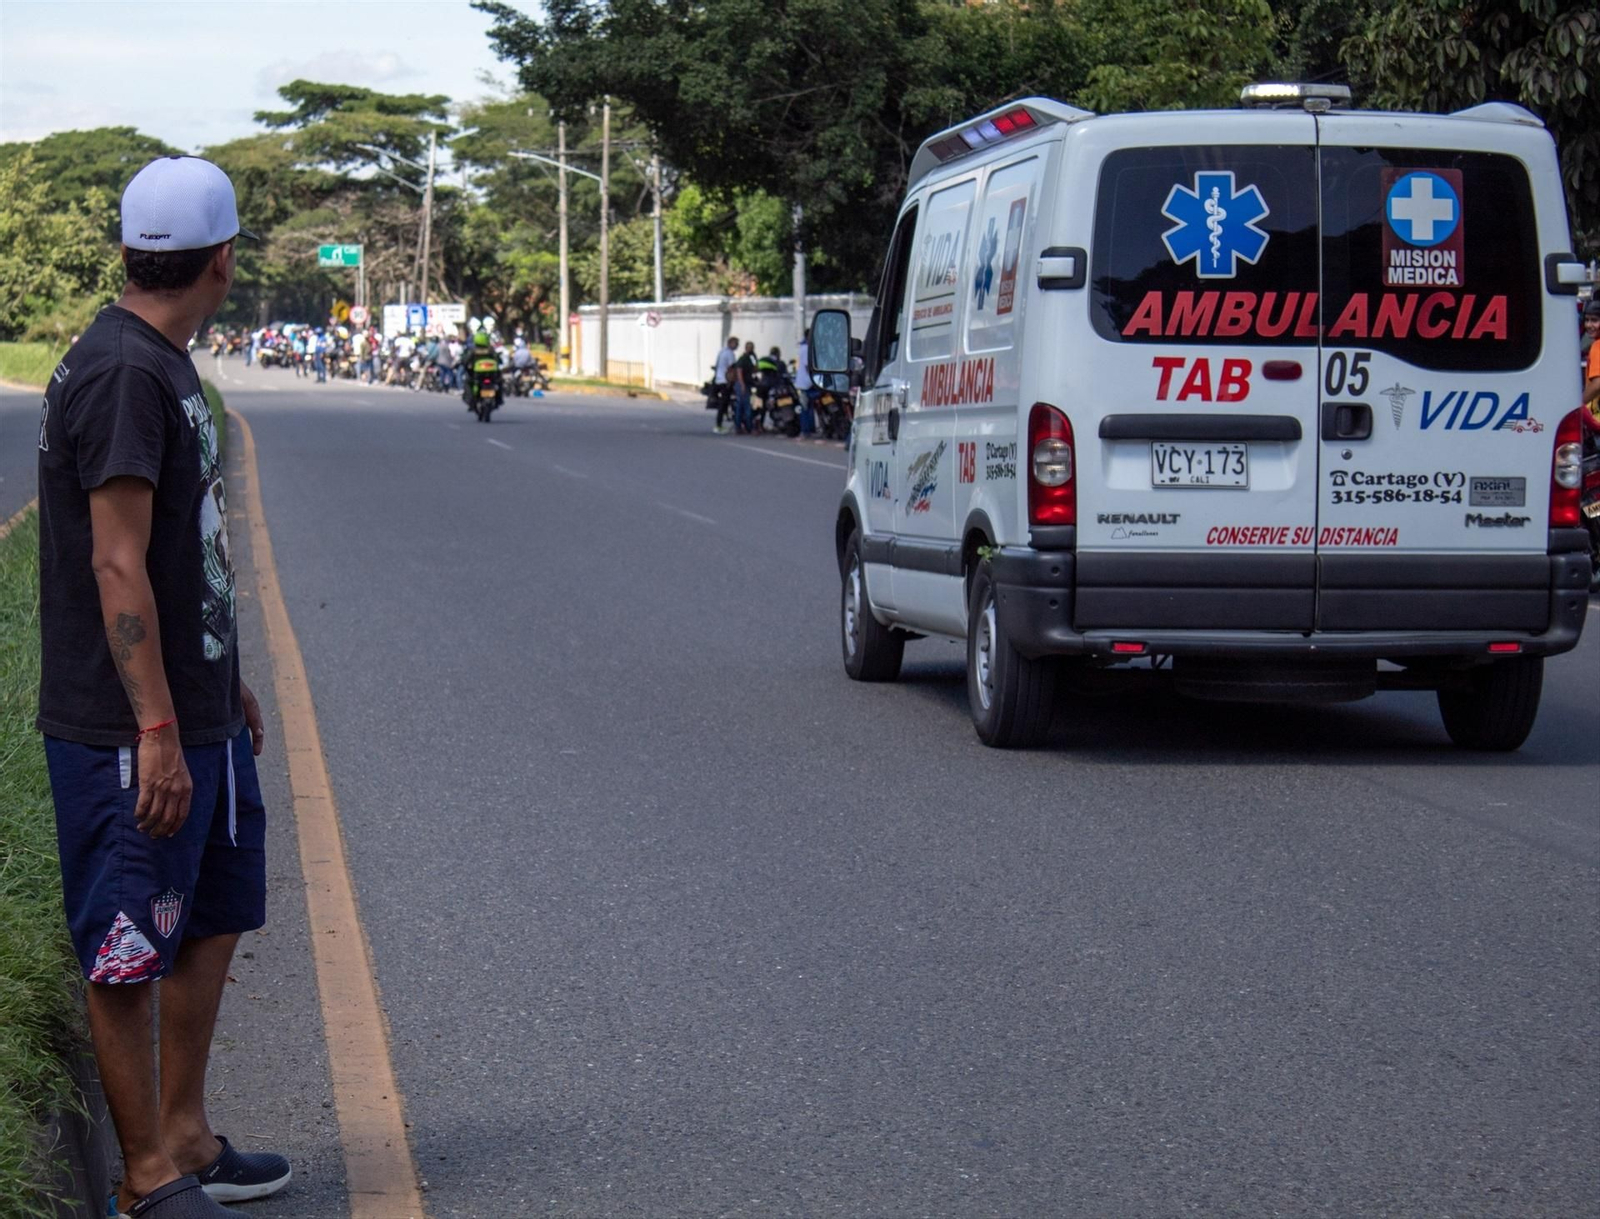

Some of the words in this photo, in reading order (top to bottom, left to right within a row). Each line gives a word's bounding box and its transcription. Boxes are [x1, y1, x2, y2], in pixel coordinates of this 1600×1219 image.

[1390, 249, 1456, 268] MISION
[1388, 267, 1460, 286] MEDICA
[1121, 290, 1509, 340] AMBULANCIA
[920, 357, 995, 408] AMBULANCIA
[1151, 357, 1253, 403] TAB
[1325, 351, 1372, 397] 05
[1419, 391, 1531, 431] VIDA
[958, 442, 977, 484] TAB
[870, 461, 889, 498] VIDA
[1190, 476, 1210, 484] CALI
[1351, 471, 1429, 488] Cartago
[1433, 471, 1466, 488] (V)
[1331, 489, 1462, 505] 315-586-18-54
[1097, 513, 1181, 525] RENAULT
[1206, 526, 1290, 545] CONSERVE
[1291, 527, 1315, 545] SU
[1318, 527, 1399, 546] DISTANCIA
